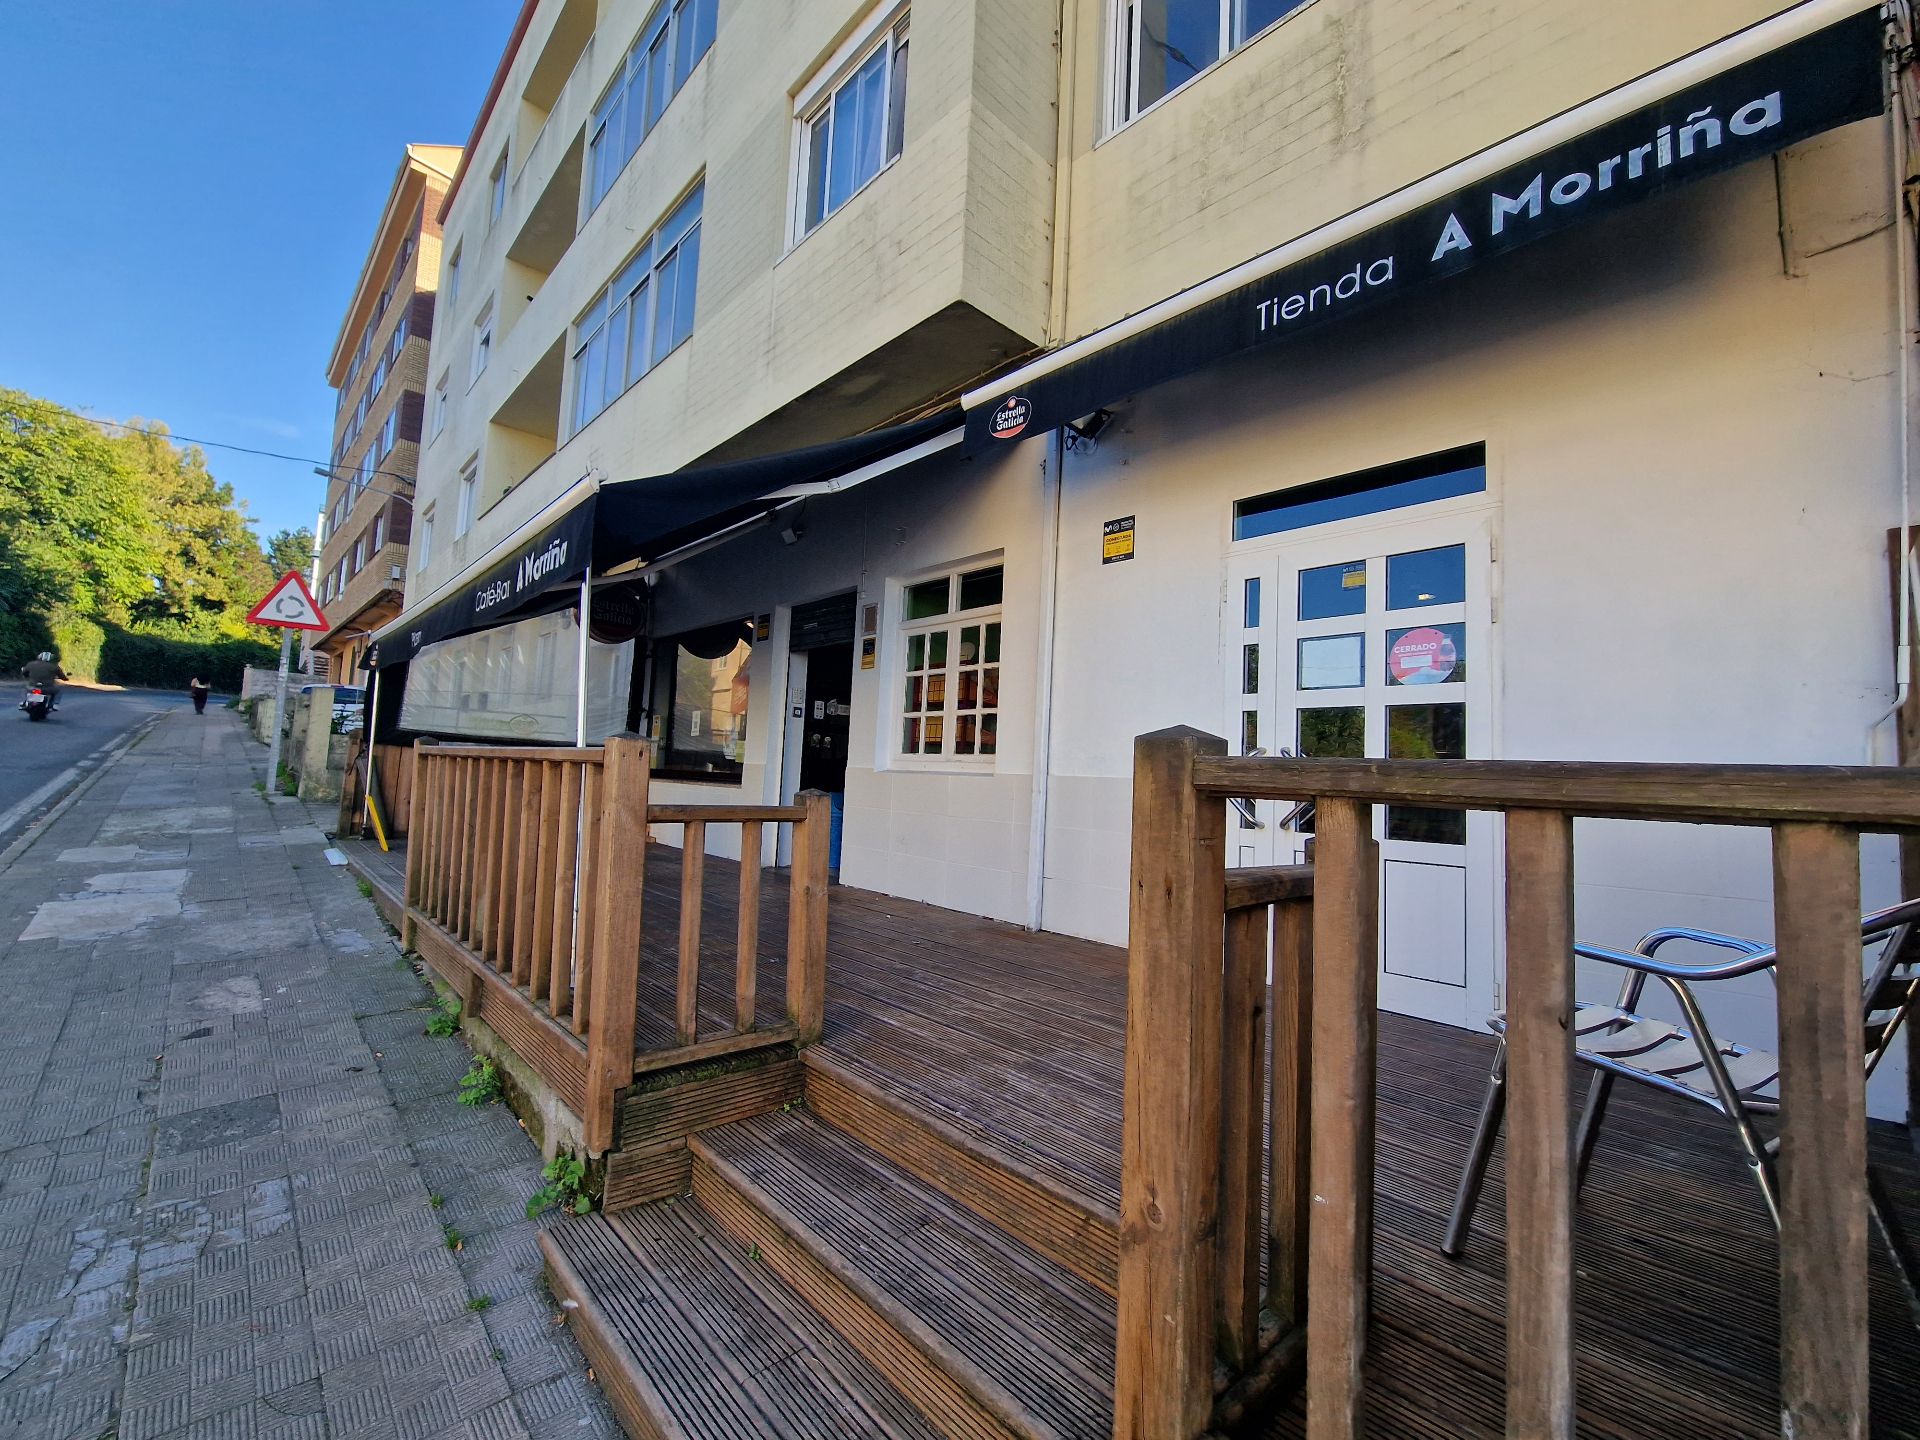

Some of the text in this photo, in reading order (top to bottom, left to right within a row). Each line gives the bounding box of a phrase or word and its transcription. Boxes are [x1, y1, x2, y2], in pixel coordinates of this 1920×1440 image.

[1256, 90, 1782, 332] Tienda A Morriña
[996, 405, 1026, 421] Estrella
[996, 415, 1024, 430] Galicia
[515, 560, 523, 593] A
[525, 538, 568, 587] Morriña
[1394, 642, 1437, 654] CERRADO
